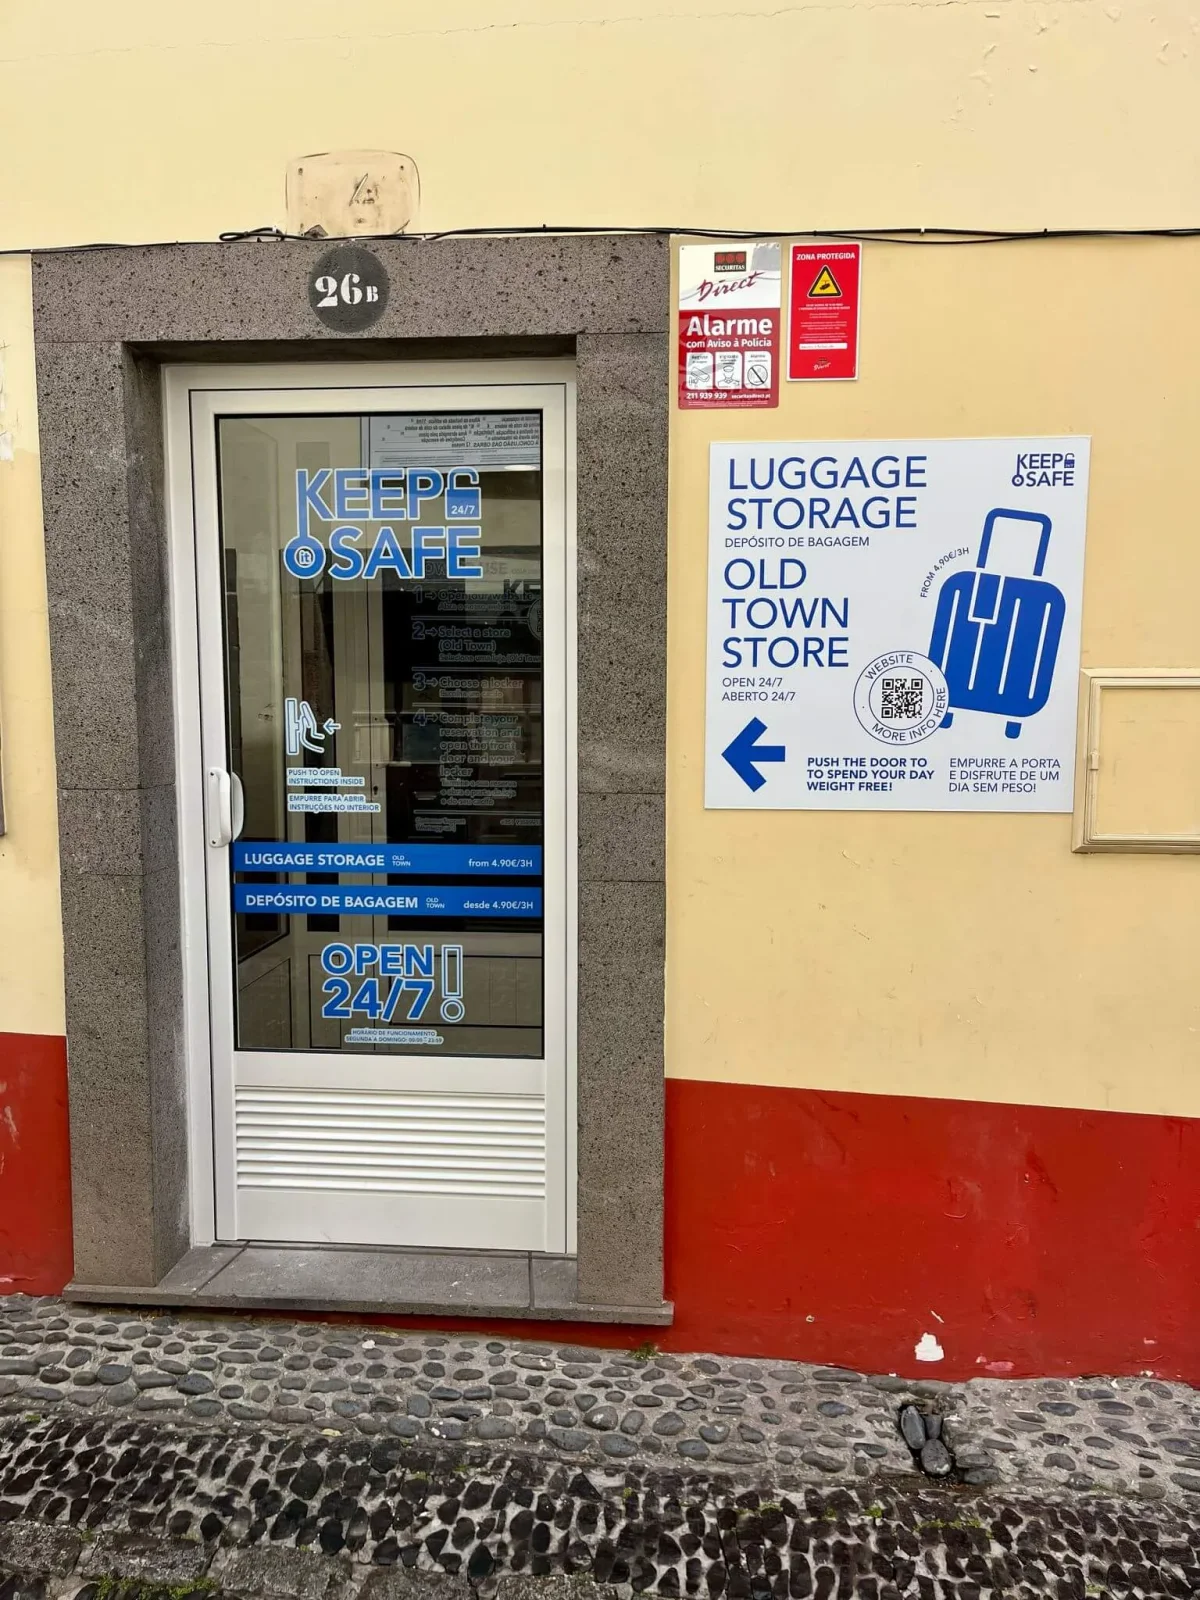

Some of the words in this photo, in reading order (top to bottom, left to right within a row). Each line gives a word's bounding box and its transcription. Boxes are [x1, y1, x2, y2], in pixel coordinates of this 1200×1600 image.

[697, 272, 765, 301] Direct
[687, 314, 773, 336] Alarme
[707, 339, 731, 348] Aviso
[733, 339, 739, 347] à
[741, 338, 772, 347] Polícia
[1017, 454, 1064, 469] KEEP
[729, 456, 927, 490] LUGGAGE
[1026, 471, 1074, 487] SAFE
[296, 467, 444, 521] KEEP
[452, 505, 475, 514] 24/7
[727, 496, 917, 530] STORAGE
[725, 536, 785, 548] DEPÓSITO
[788, 538, 804, 547] DE
[808, 536, 869, 547] BAGAGEM
[299, 551, 310, 564] it
[328, 525, 483, 580] SAFE
[724, 558, 807, 590] OLD
[920, 571, 935, 598] FROM
[722, 597, 848, 629] TOWN
[412, 621, 425, 640] 2
[438, 626, 472, 637] Select
[482, 627, 511, 637] store
[465, 640, 496, 652] Town)
[722, 636, 849, 668] STORE
[865, 654, 913, 680] WEBSITE
[413, 672, 426, 691] 3
[438, 676, 480, 688] Choose
[490, 676, 524, 688] locker
[722, 678, 755, 687] OPEN
[759, 677, 783, 688] 24/7
[722, 692, 769, 701] ABERTO
[772, 691, 796, 702] 24/7
[413, 708, 427, 726] 4
[439, 712, 490, 725] Complete
[491, 715, 518, 726] your
[872, 723, 906, 741] MORE
[909, 719, 936, 740] INFO
[934, 687, 945, 718] HERE
[439, 727, 498, 737] reservation
[500, 726, 521, 737] and
[439, 742, 468, 753] open
[469, 740, 488, 750] the
[488, 741, 516, 750] front
[439, 752, 467, 763] door
[468, 753, 488, 763] and
[489, 754, 516, 766] your
[807, 757, 839, 767] PUSH
[843, 758, 867, 767] THE
[870, 757, 907, 767] DOOR
[910, 758, 927, 767] TO
[950, 758, 1006, 768] EMPURRE
[1009, 759, 1018, 768] A
[1022, 758, 1061, 768] PORTA
[439, 765, 474, 776] locker
[807, 770, 824, 779] TO
[828, 770, 867, 779] SPEND
[870, 770, 905, 779] YOUR
[910, 770, 935, 780] DAY
[950, 770, 956, 780] E
[960, 770, 1016, 780] DISFRUTE
[1020, 771, 1036, 780] DE
[1040, 771, 1059, 780] UM
[807, 781, 855, 791] WEIGHT
[859, 782, 893, 791] FREE!
[949, 782, 970, 792] DIA
[973, 783, 997, 792] SEM
[1002, 783, 1036, 792] PESO!
[245, 853, 313, 865] LUGGAGE
[318, 854, 385, 866] STORAGE
[469, 859, 489, 867] from
[491, 859, 532, 868] 4.90€/3H
[246, 892, 316, 907] DEPÓSITO
[322, 896, 340, 907] DE
[345, 896, 418, 908] BAGAGEM
[464, 901, 490, 909] desde
[492, 901, 533, 910] 4.90€/3H
[321, 943, 434, 977] OPEN
[322, 977, 435, 1022] 24/7
